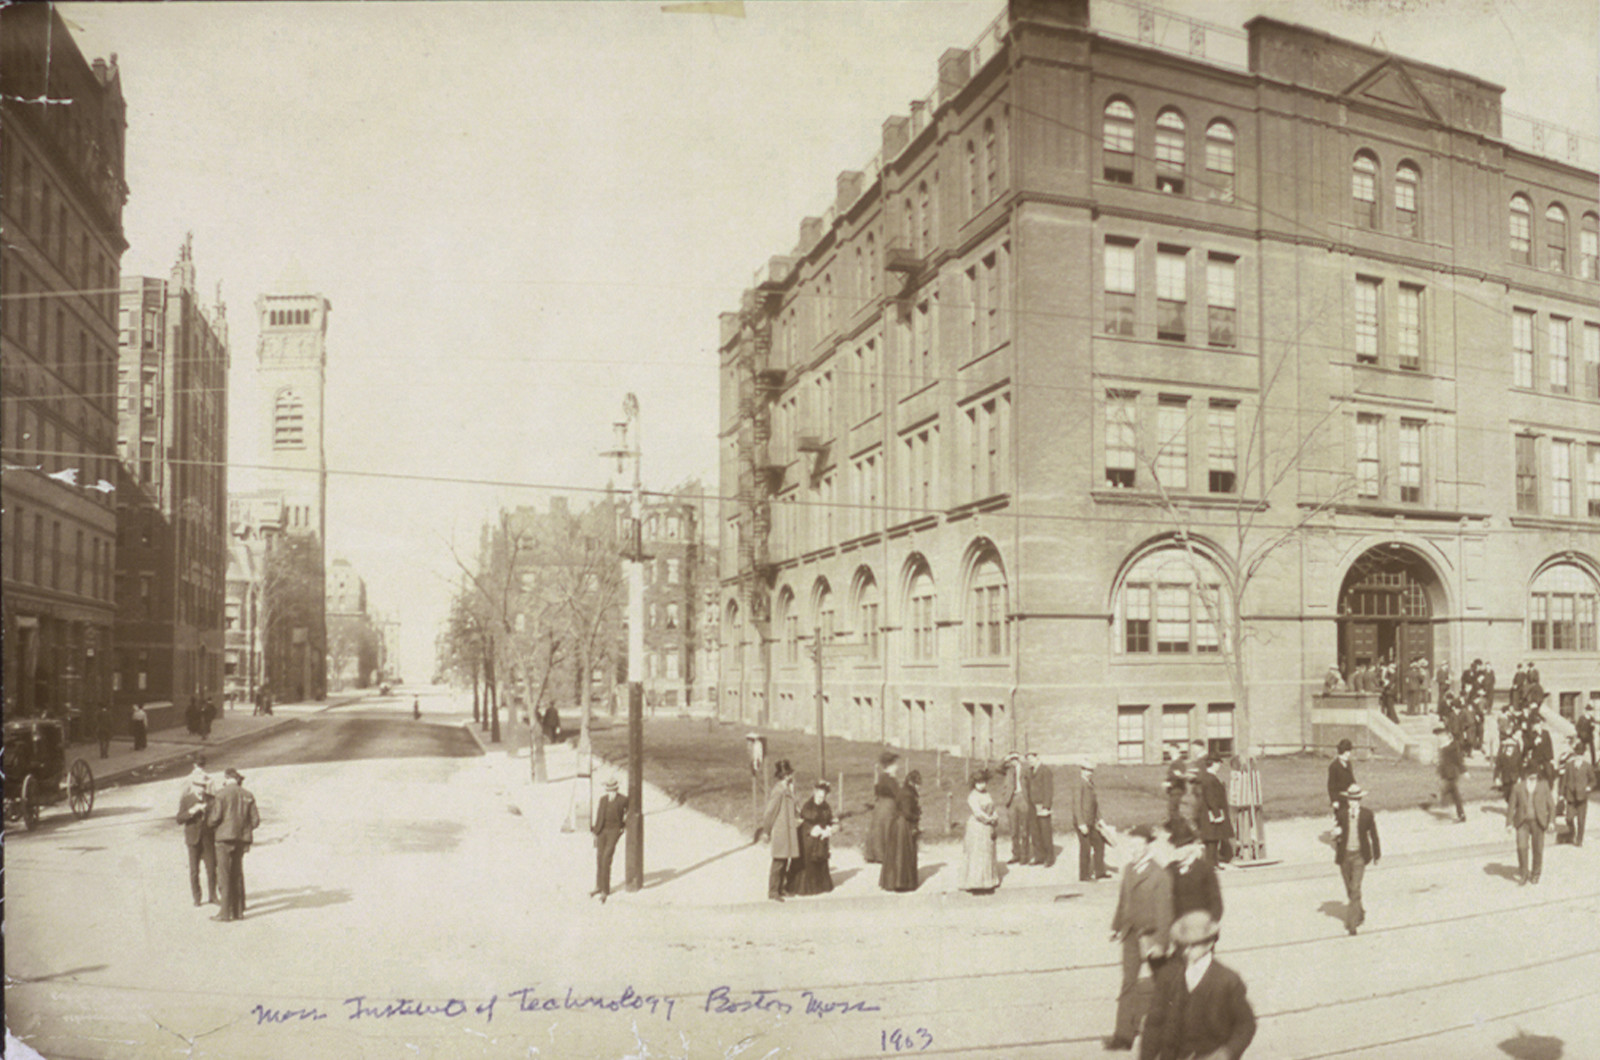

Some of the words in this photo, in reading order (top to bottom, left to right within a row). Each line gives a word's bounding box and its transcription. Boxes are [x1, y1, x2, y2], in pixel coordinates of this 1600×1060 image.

[475, 994, 498, 1023] of
[507, 986, 675, 1021] Technology
[704, 986, 793, 1014] Boston
[880, 1027, 934, 1052] 1903
